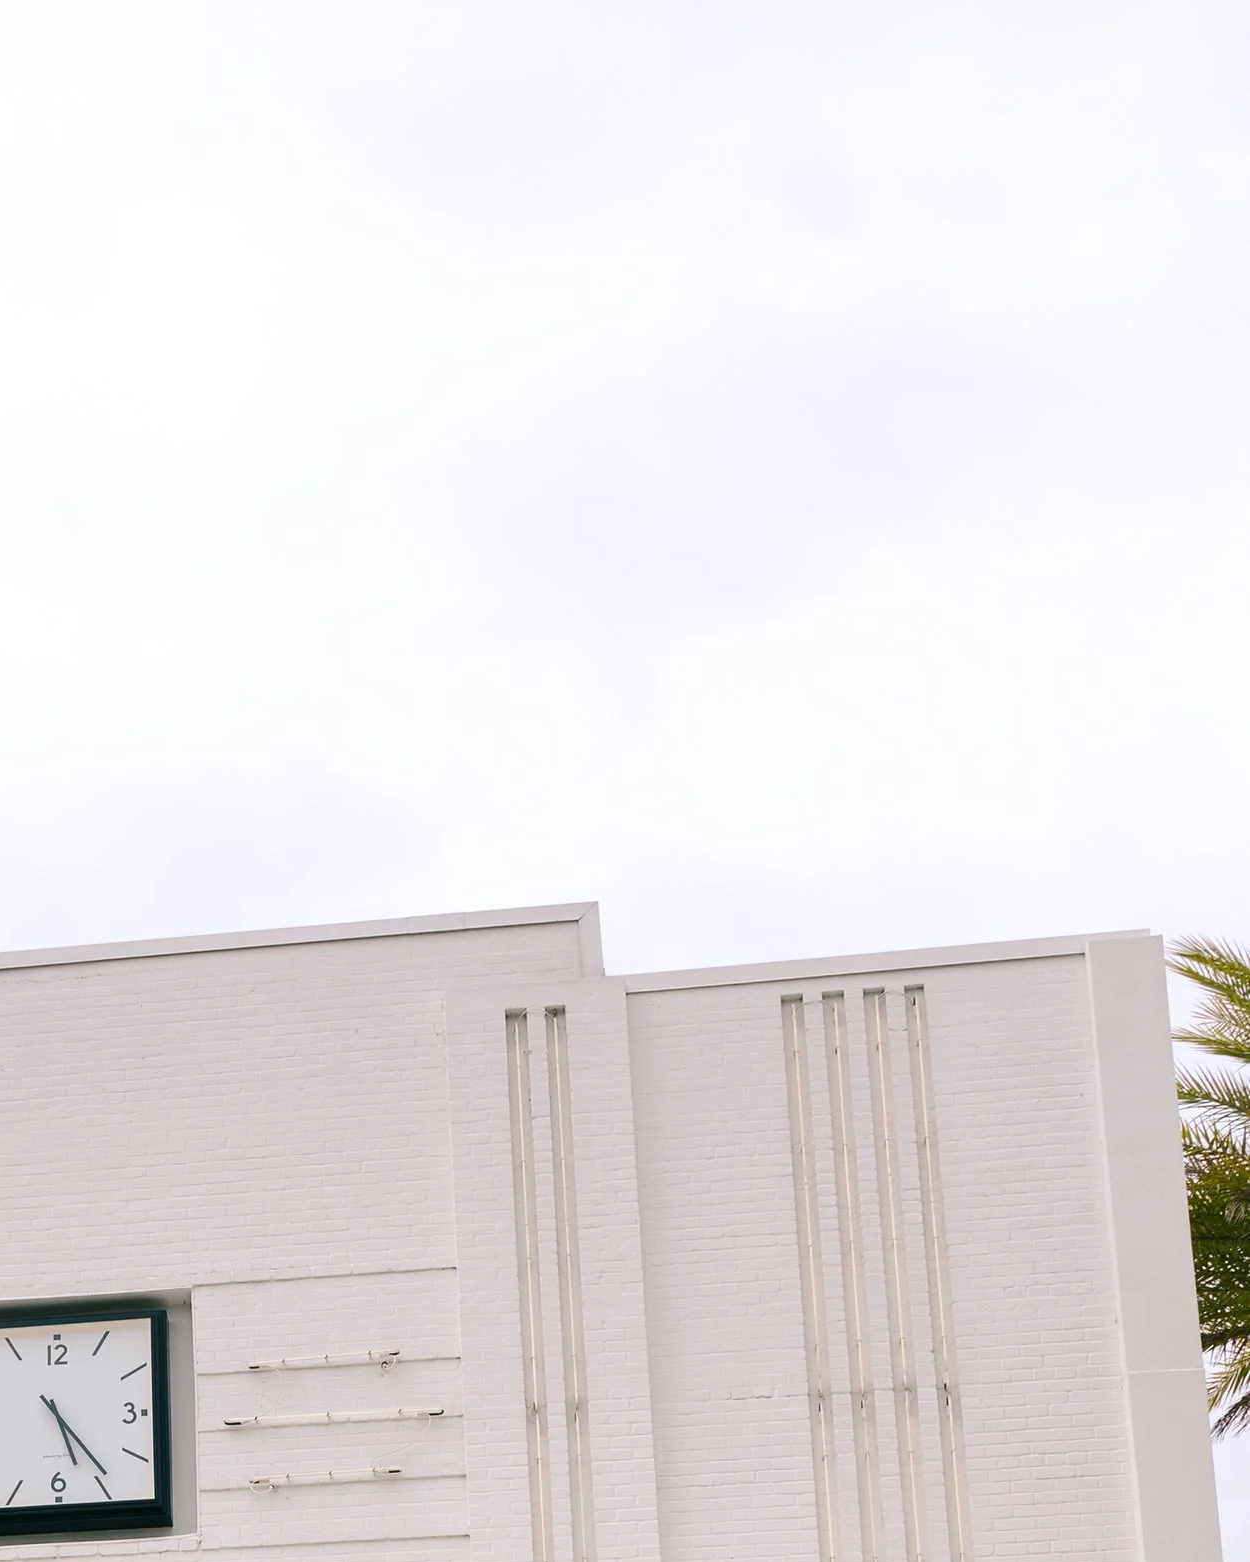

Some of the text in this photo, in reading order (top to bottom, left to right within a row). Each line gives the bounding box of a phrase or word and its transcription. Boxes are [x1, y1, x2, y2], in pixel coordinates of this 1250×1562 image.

[47, 1344, 68, 1366] 12
[122, 1402, 137, 1425] 3
[50, 1471, 67, 1493] 6
